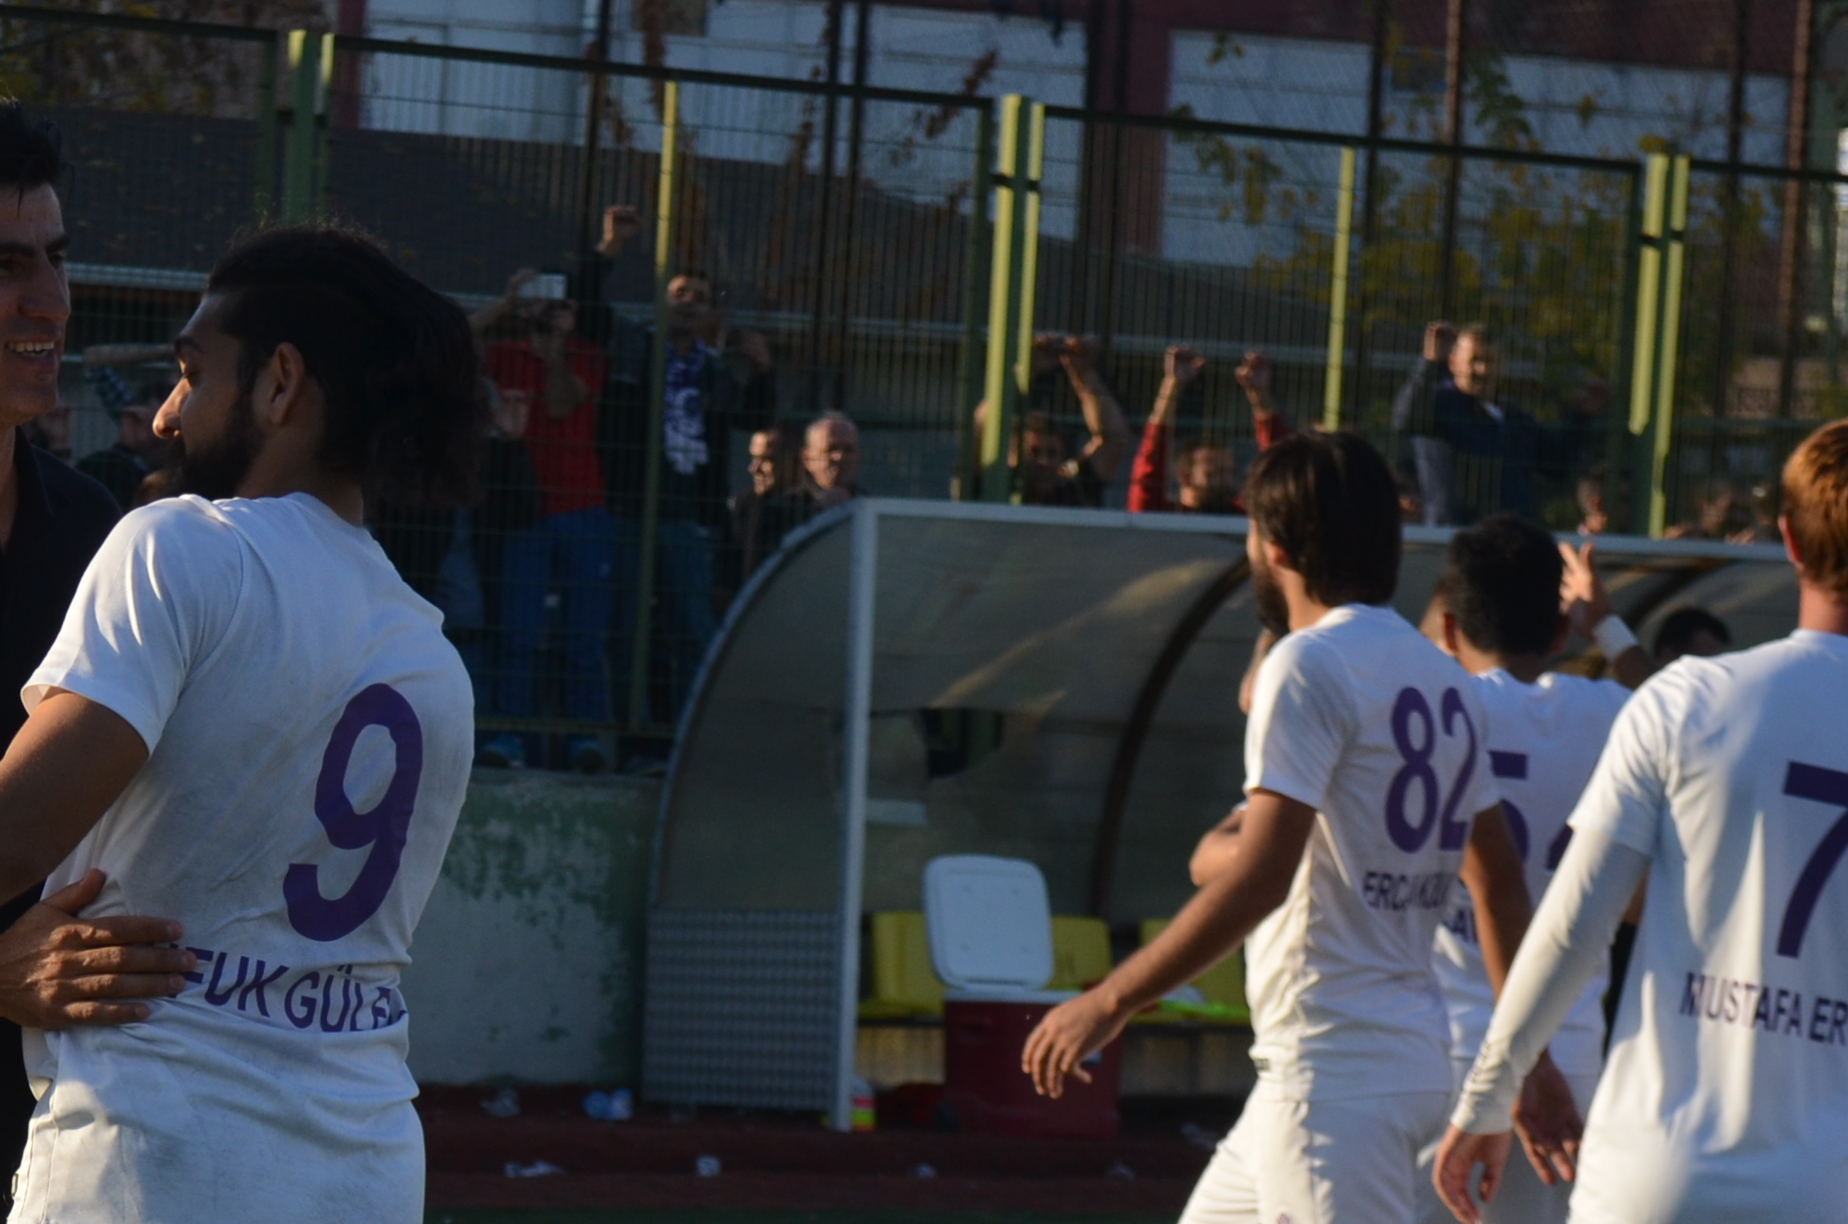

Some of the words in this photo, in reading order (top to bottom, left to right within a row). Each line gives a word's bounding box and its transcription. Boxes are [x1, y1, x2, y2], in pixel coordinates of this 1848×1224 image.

[282, 682, 423, 943] 9
[1385, 687, 1477, 853] 82
[1775, 759, 1848, 959] 7
[168, 942, 290, 1018] FUK
[1680, 971, 1802, 1038] MUSTAFA
